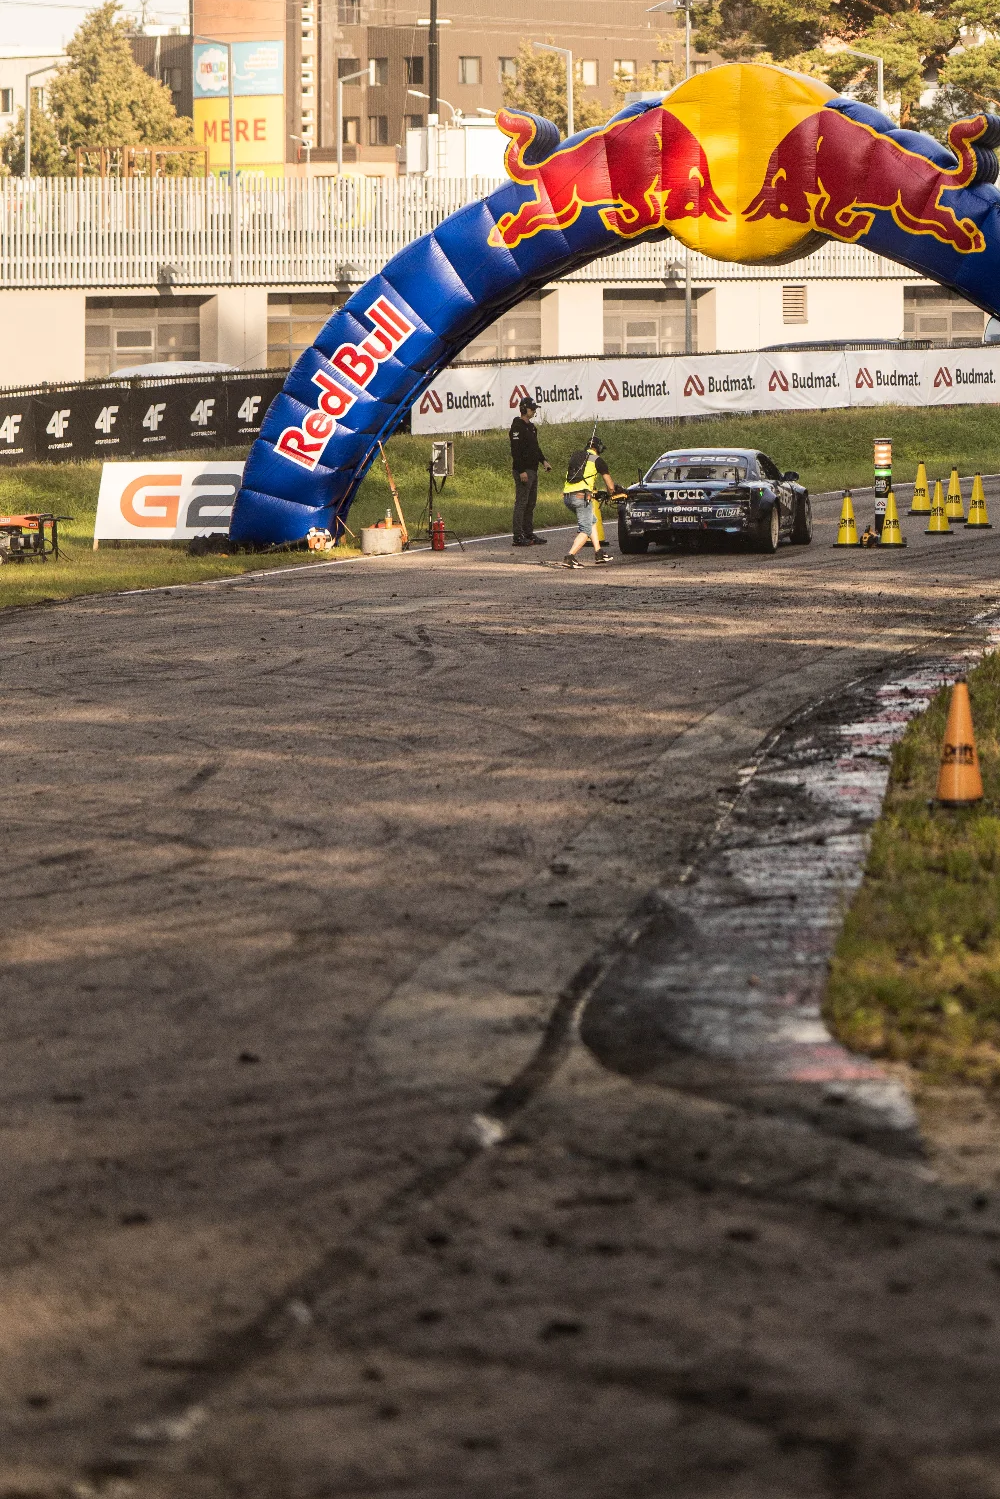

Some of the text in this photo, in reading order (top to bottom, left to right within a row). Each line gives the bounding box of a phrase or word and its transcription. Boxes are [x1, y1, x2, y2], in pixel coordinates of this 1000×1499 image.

[203, 118, 267, 143] MERE
[273, 295, 417, 471] Red Bull
[622, 380, 670, 398] Budmat.
[708, 375, 756, 393] Budmat.
[791, 371, 840, 389] Budmat.
[876, 369, 921, 387] Budmat.
[955, 368, 996, 385] Budmat.
[446, 391, 494, 410] Budmat.
[535, 384, 583, 404] Budmat.
[95, 406, 119, 433] 4F
[143, 403, 166, 431] 4F
[190, 399, 215, 426] 4F
[238, 396, 261, 422] 4F
[0, 414, 22, 443] 4F
[46, 410, 71, 438] 4F
[120, 474, 242, 528] G2
